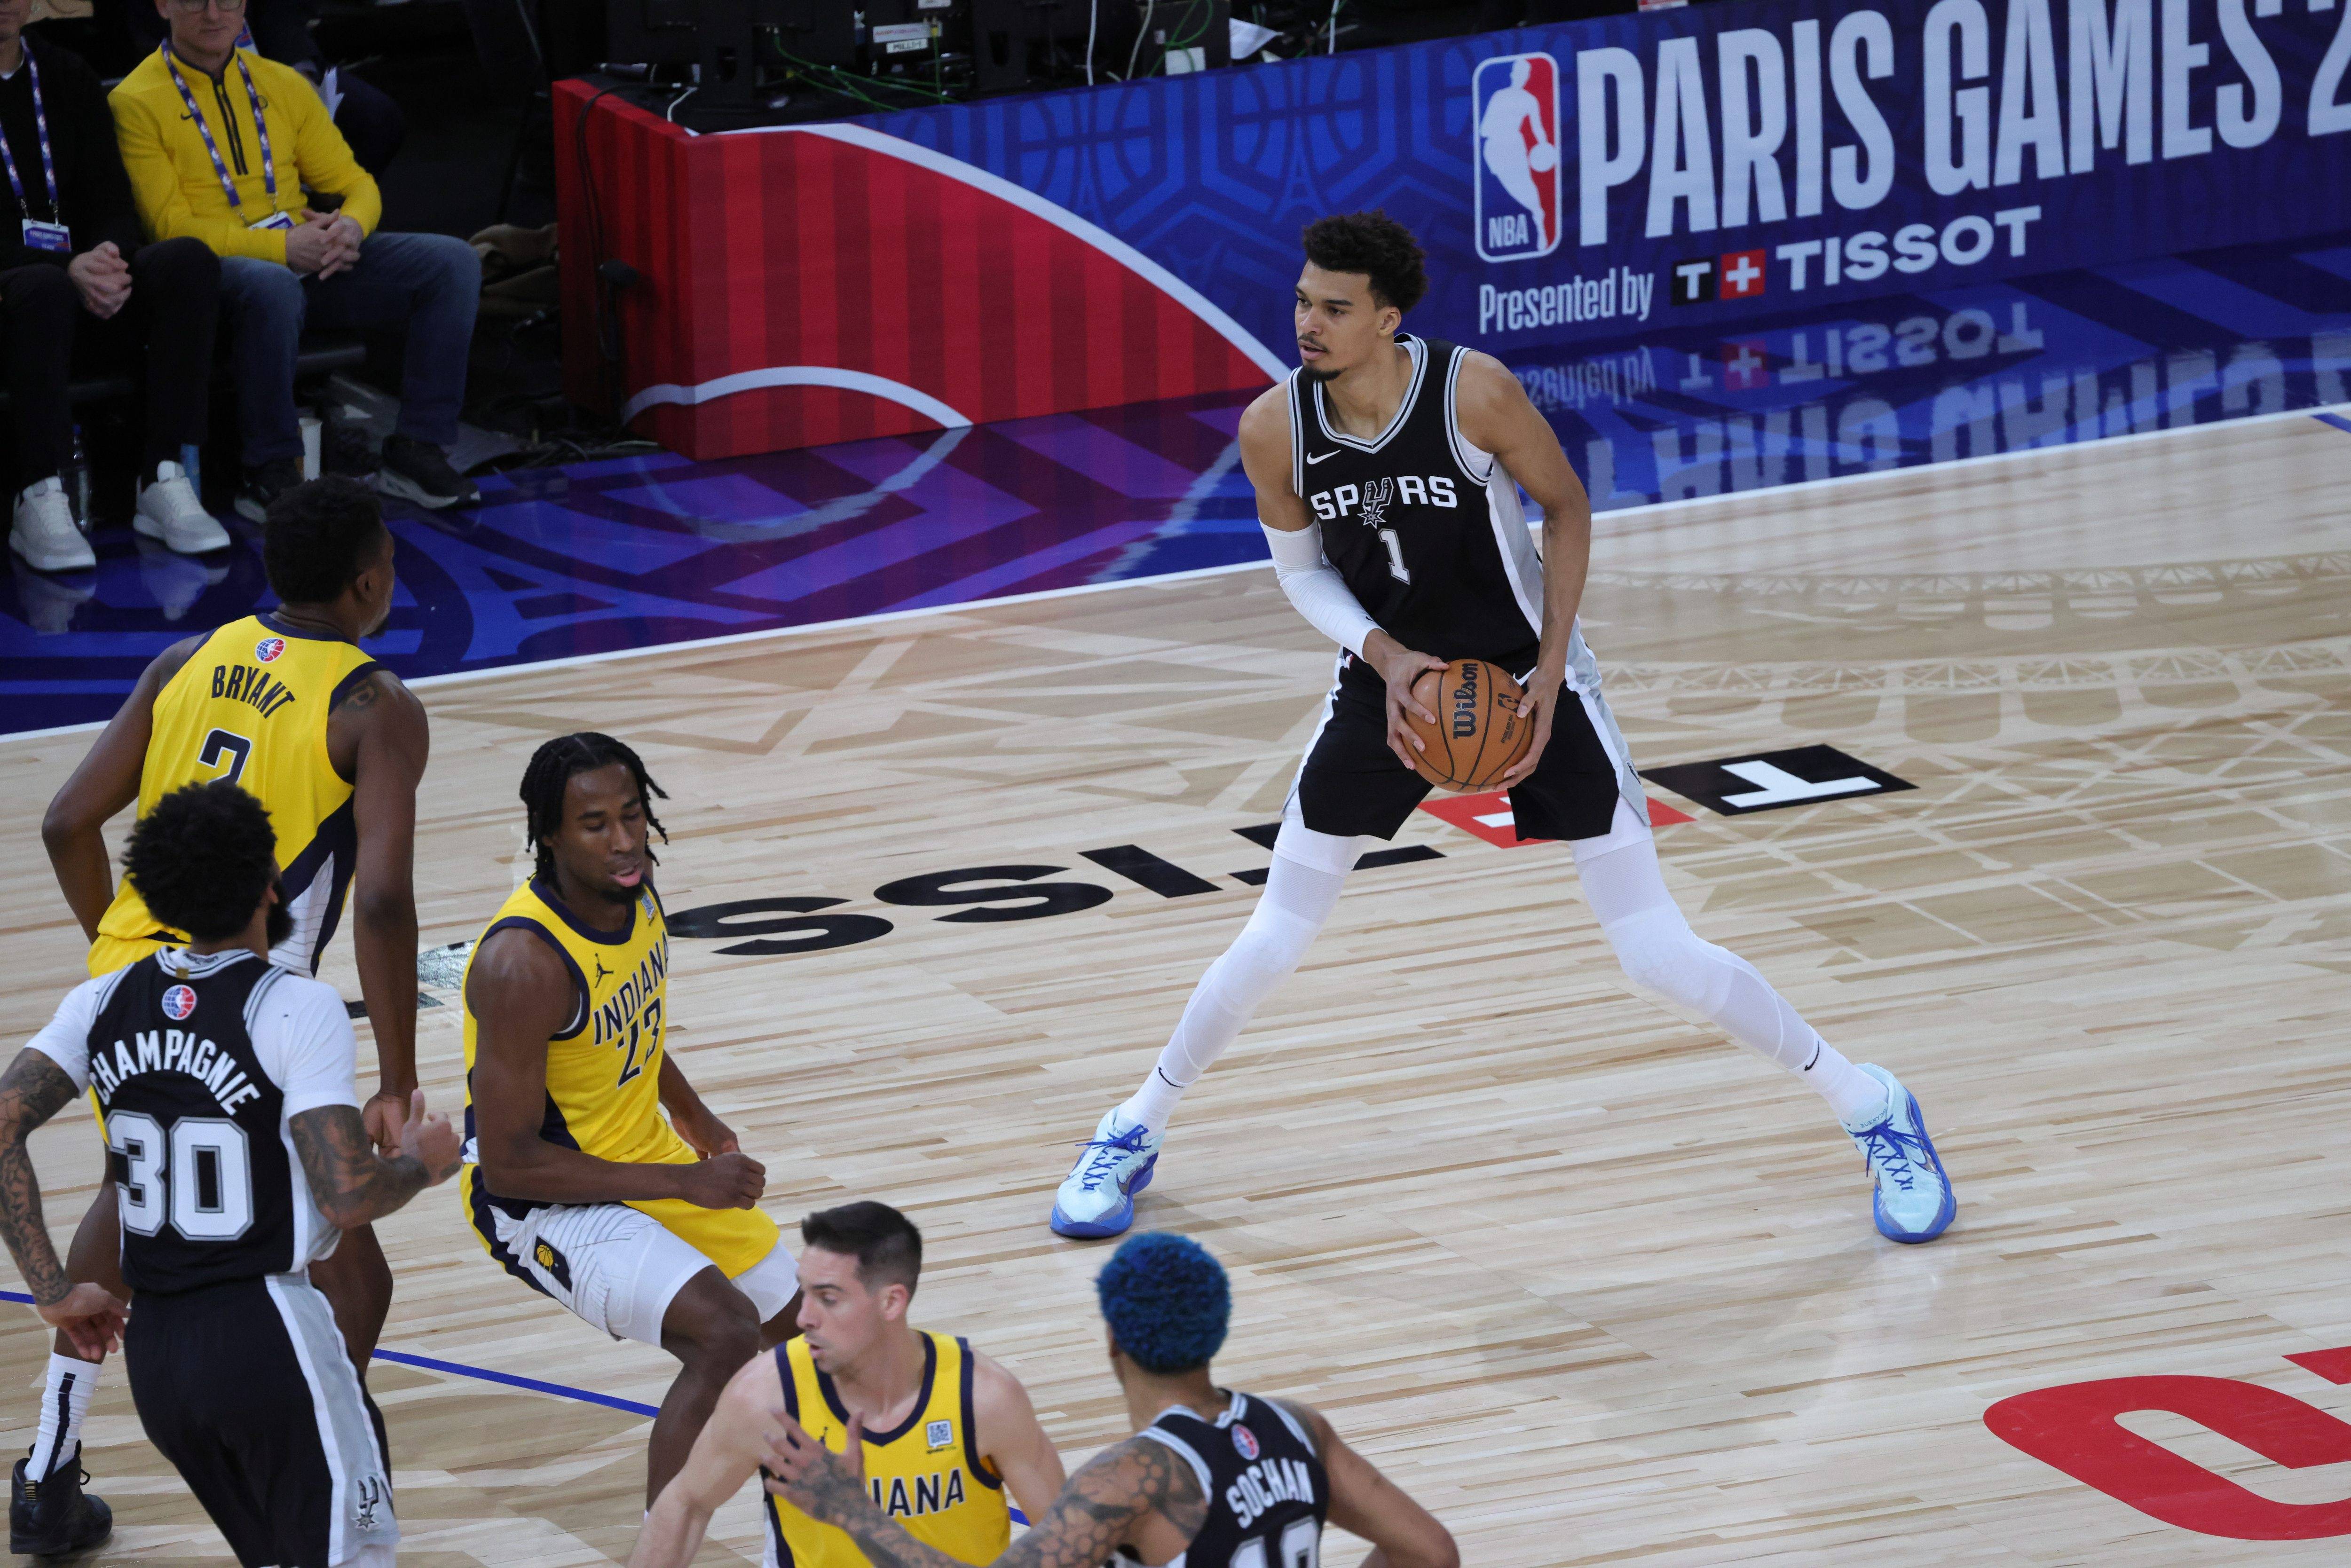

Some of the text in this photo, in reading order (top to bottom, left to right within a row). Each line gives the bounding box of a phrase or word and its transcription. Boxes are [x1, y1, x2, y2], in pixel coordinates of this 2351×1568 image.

[1577, 10, 1895, 247] PARIS
[1923, 0, 2282, 196] GAMES
[1488, 214, 1529, 248] NBA
[1676, 205, 2042, 299] T TISSOT
[1479, 266, 1654, 335] Presented by
[1310, 475, 1458, 528] SPURS
[1378, 528, 1410, 585] 1
[211, 664, 296, 719] BRYANT
[1452, 663, 1478, 740] Wilson
[615, 997, 662, 1089] 23
[104, 1109, 255, 1241] 30
[1225, 1458, 1314, 1529] SOCHAN
